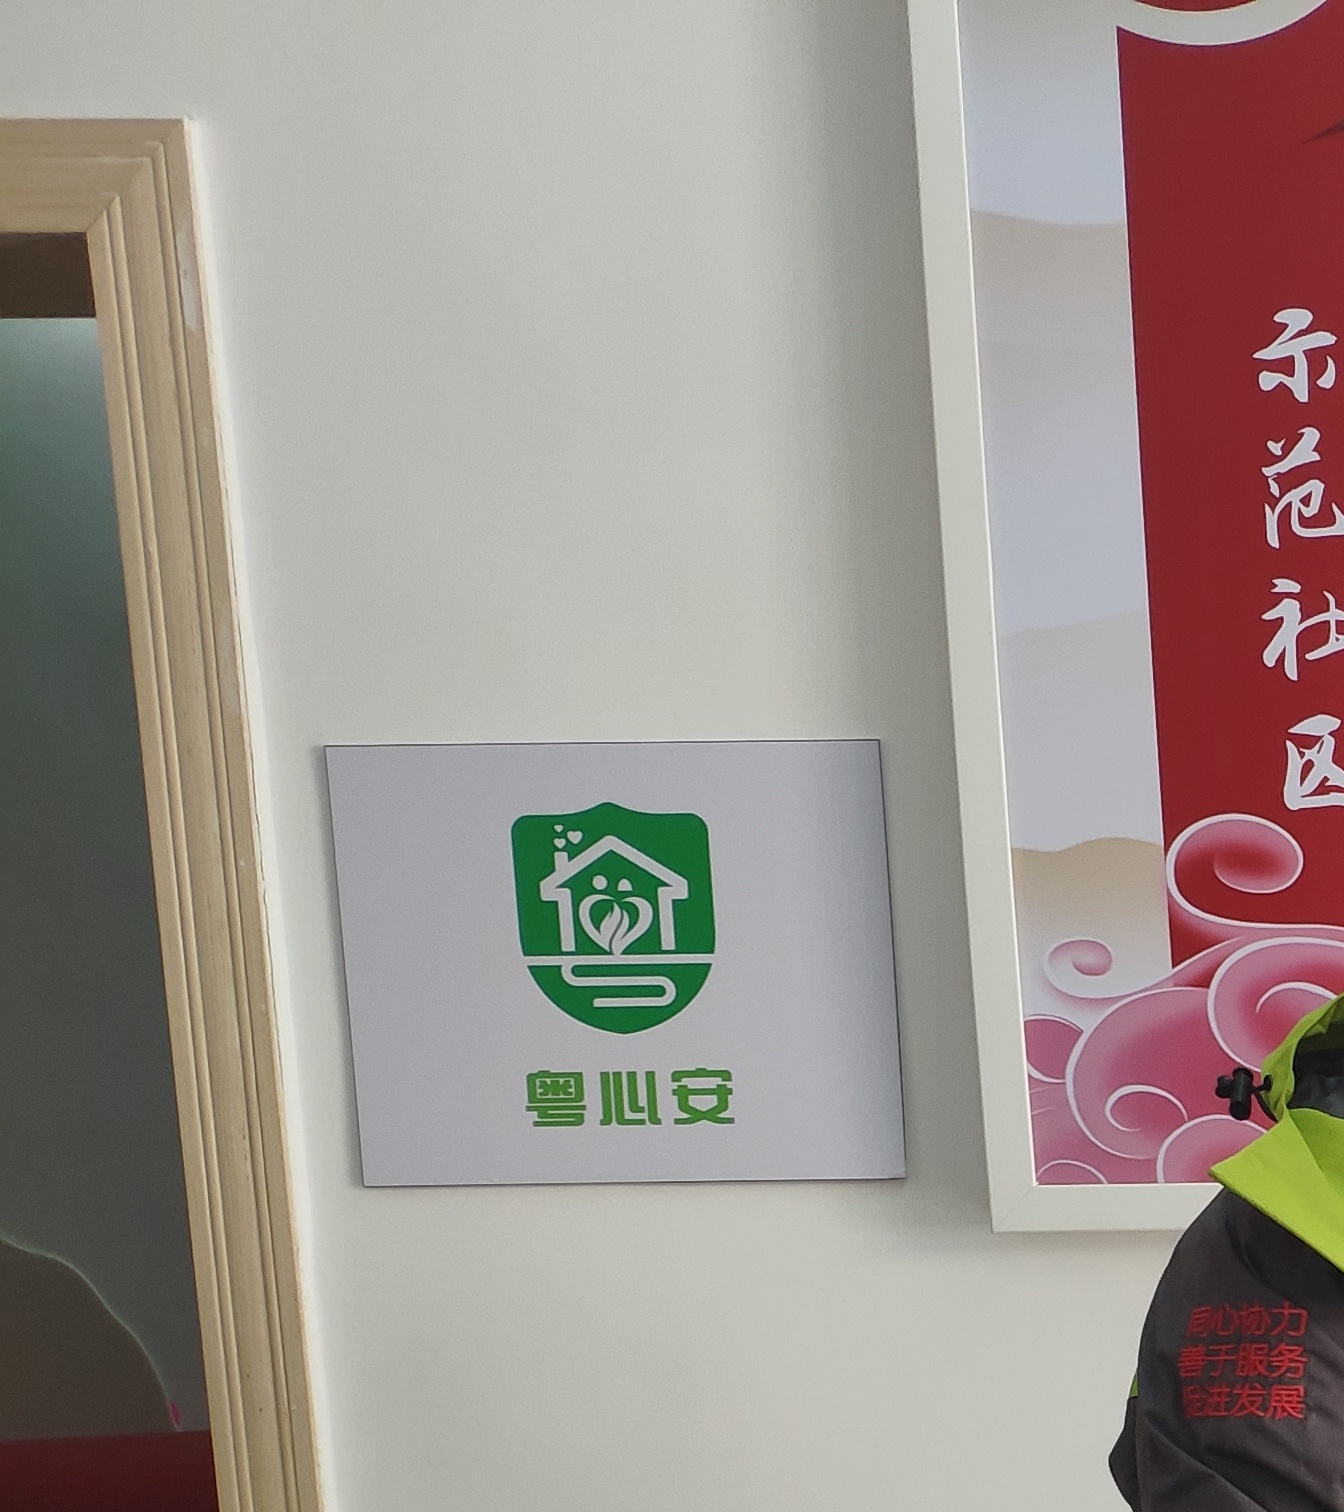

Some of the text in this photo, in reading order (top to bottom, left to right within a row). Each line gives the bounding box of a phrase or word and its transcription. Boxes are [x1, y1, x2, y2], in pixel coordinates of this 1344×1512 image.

[525, 1067, 735, 1127] 粤心安
[1178, 1342, 1308, 1378] 善于服务
